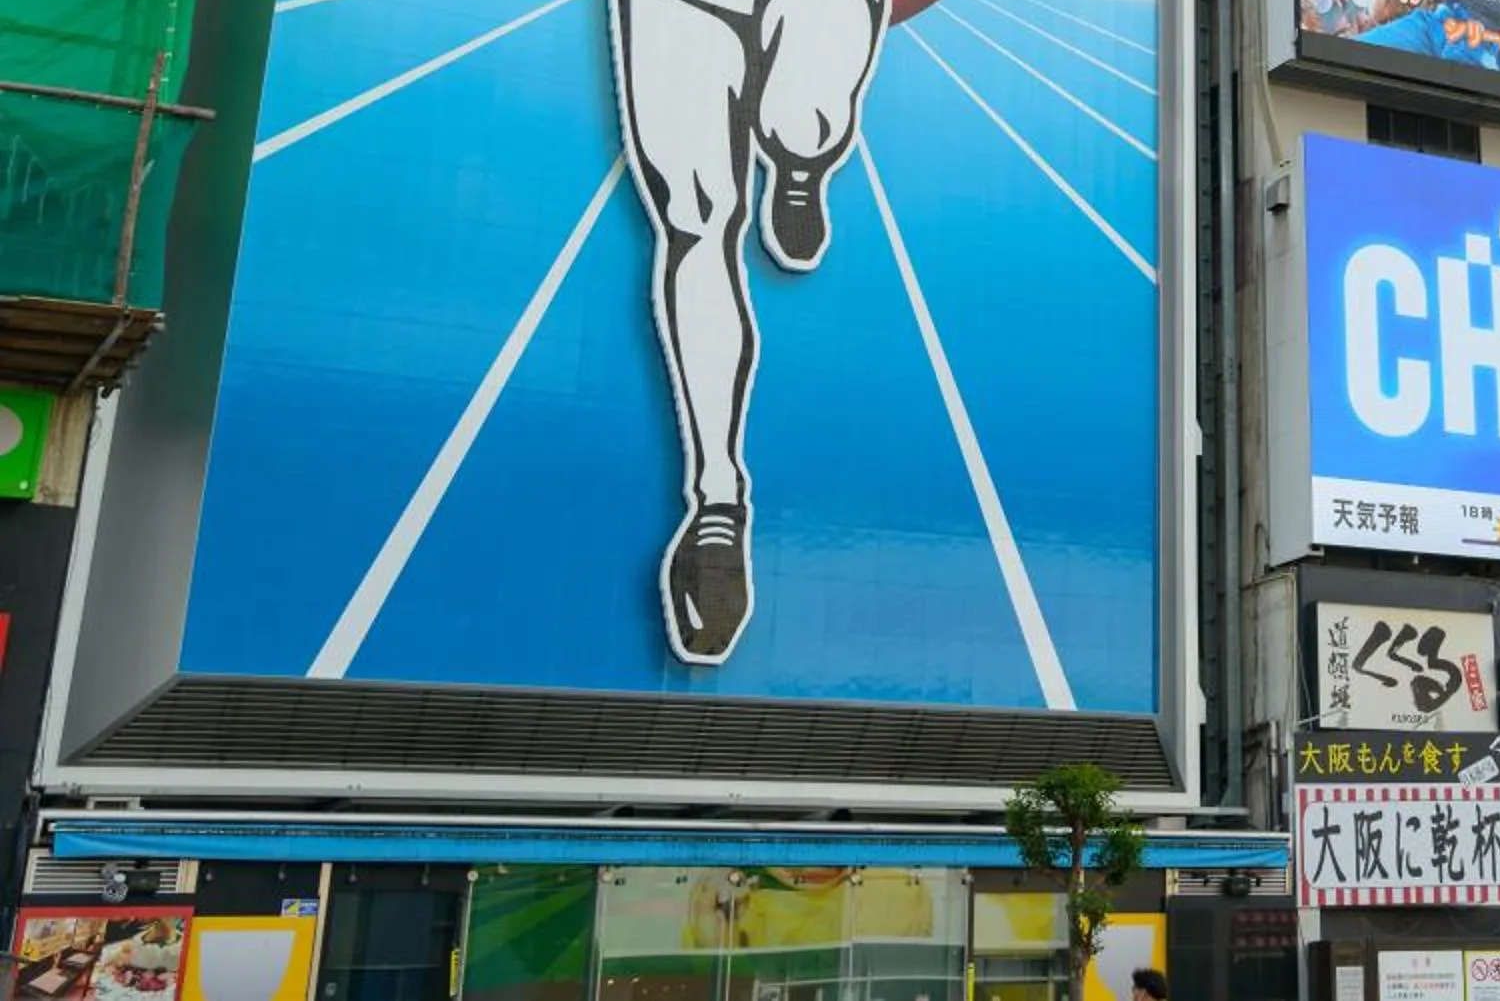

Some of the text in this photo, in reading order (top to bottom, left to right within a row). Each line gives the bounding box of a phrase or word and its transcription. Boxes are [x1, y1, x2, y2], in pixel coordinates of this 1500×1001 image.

[1332, 498, 1421, 536] 天気予報
[1461, 504, 1494, 520] 18時
[1352, 620, 1463, 713] くくる
[1300, 740, 1470, 776] 大阪もんを食す
